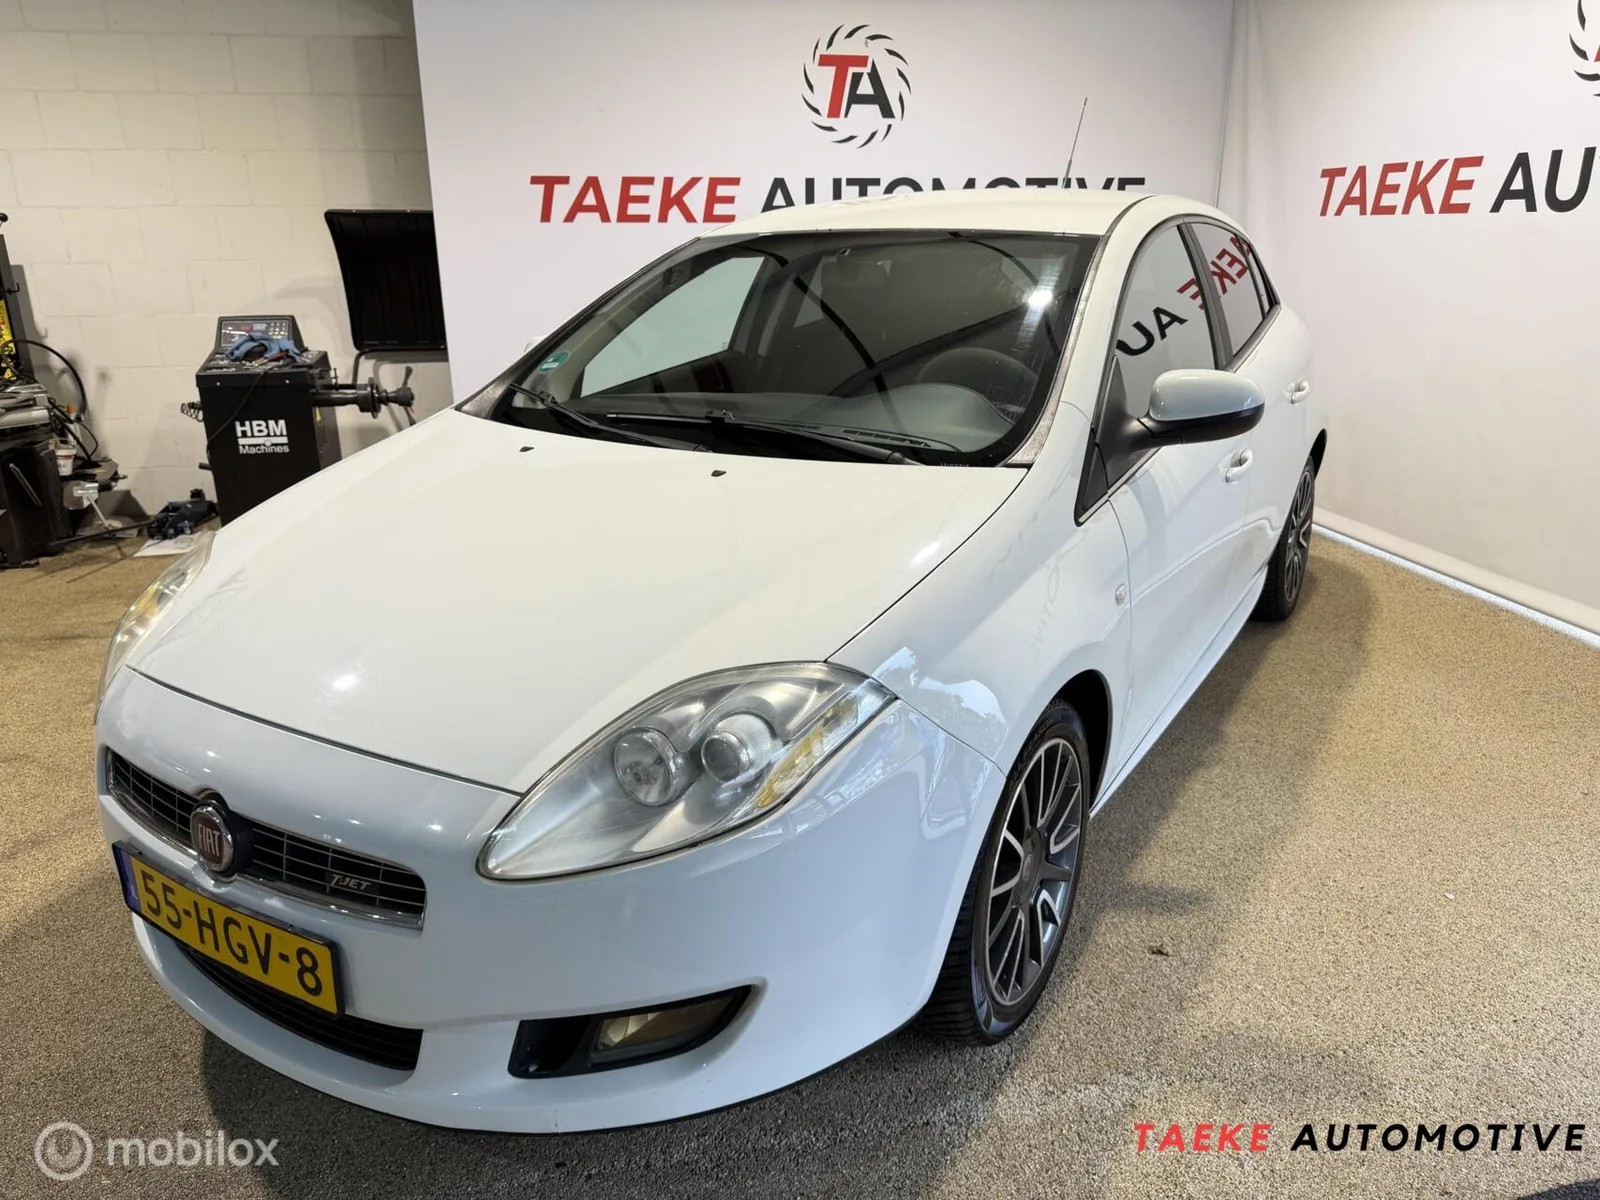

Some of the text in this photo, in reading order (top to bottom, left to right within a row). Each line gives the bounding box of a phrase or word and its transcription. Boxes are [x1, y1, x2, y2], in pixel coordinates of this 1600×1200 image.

[818, 53, 895, 119] TA
[531, 175, 741, 223] TAEKE
[1319, 156, 1484, 217] TAEKE
[235, 419, 288, 437] HBM
[239, 444, 290, 455] Machines
[198, 823, 220, 857] FIAT
[140, 870, 323, 998] 55-HGV-8
